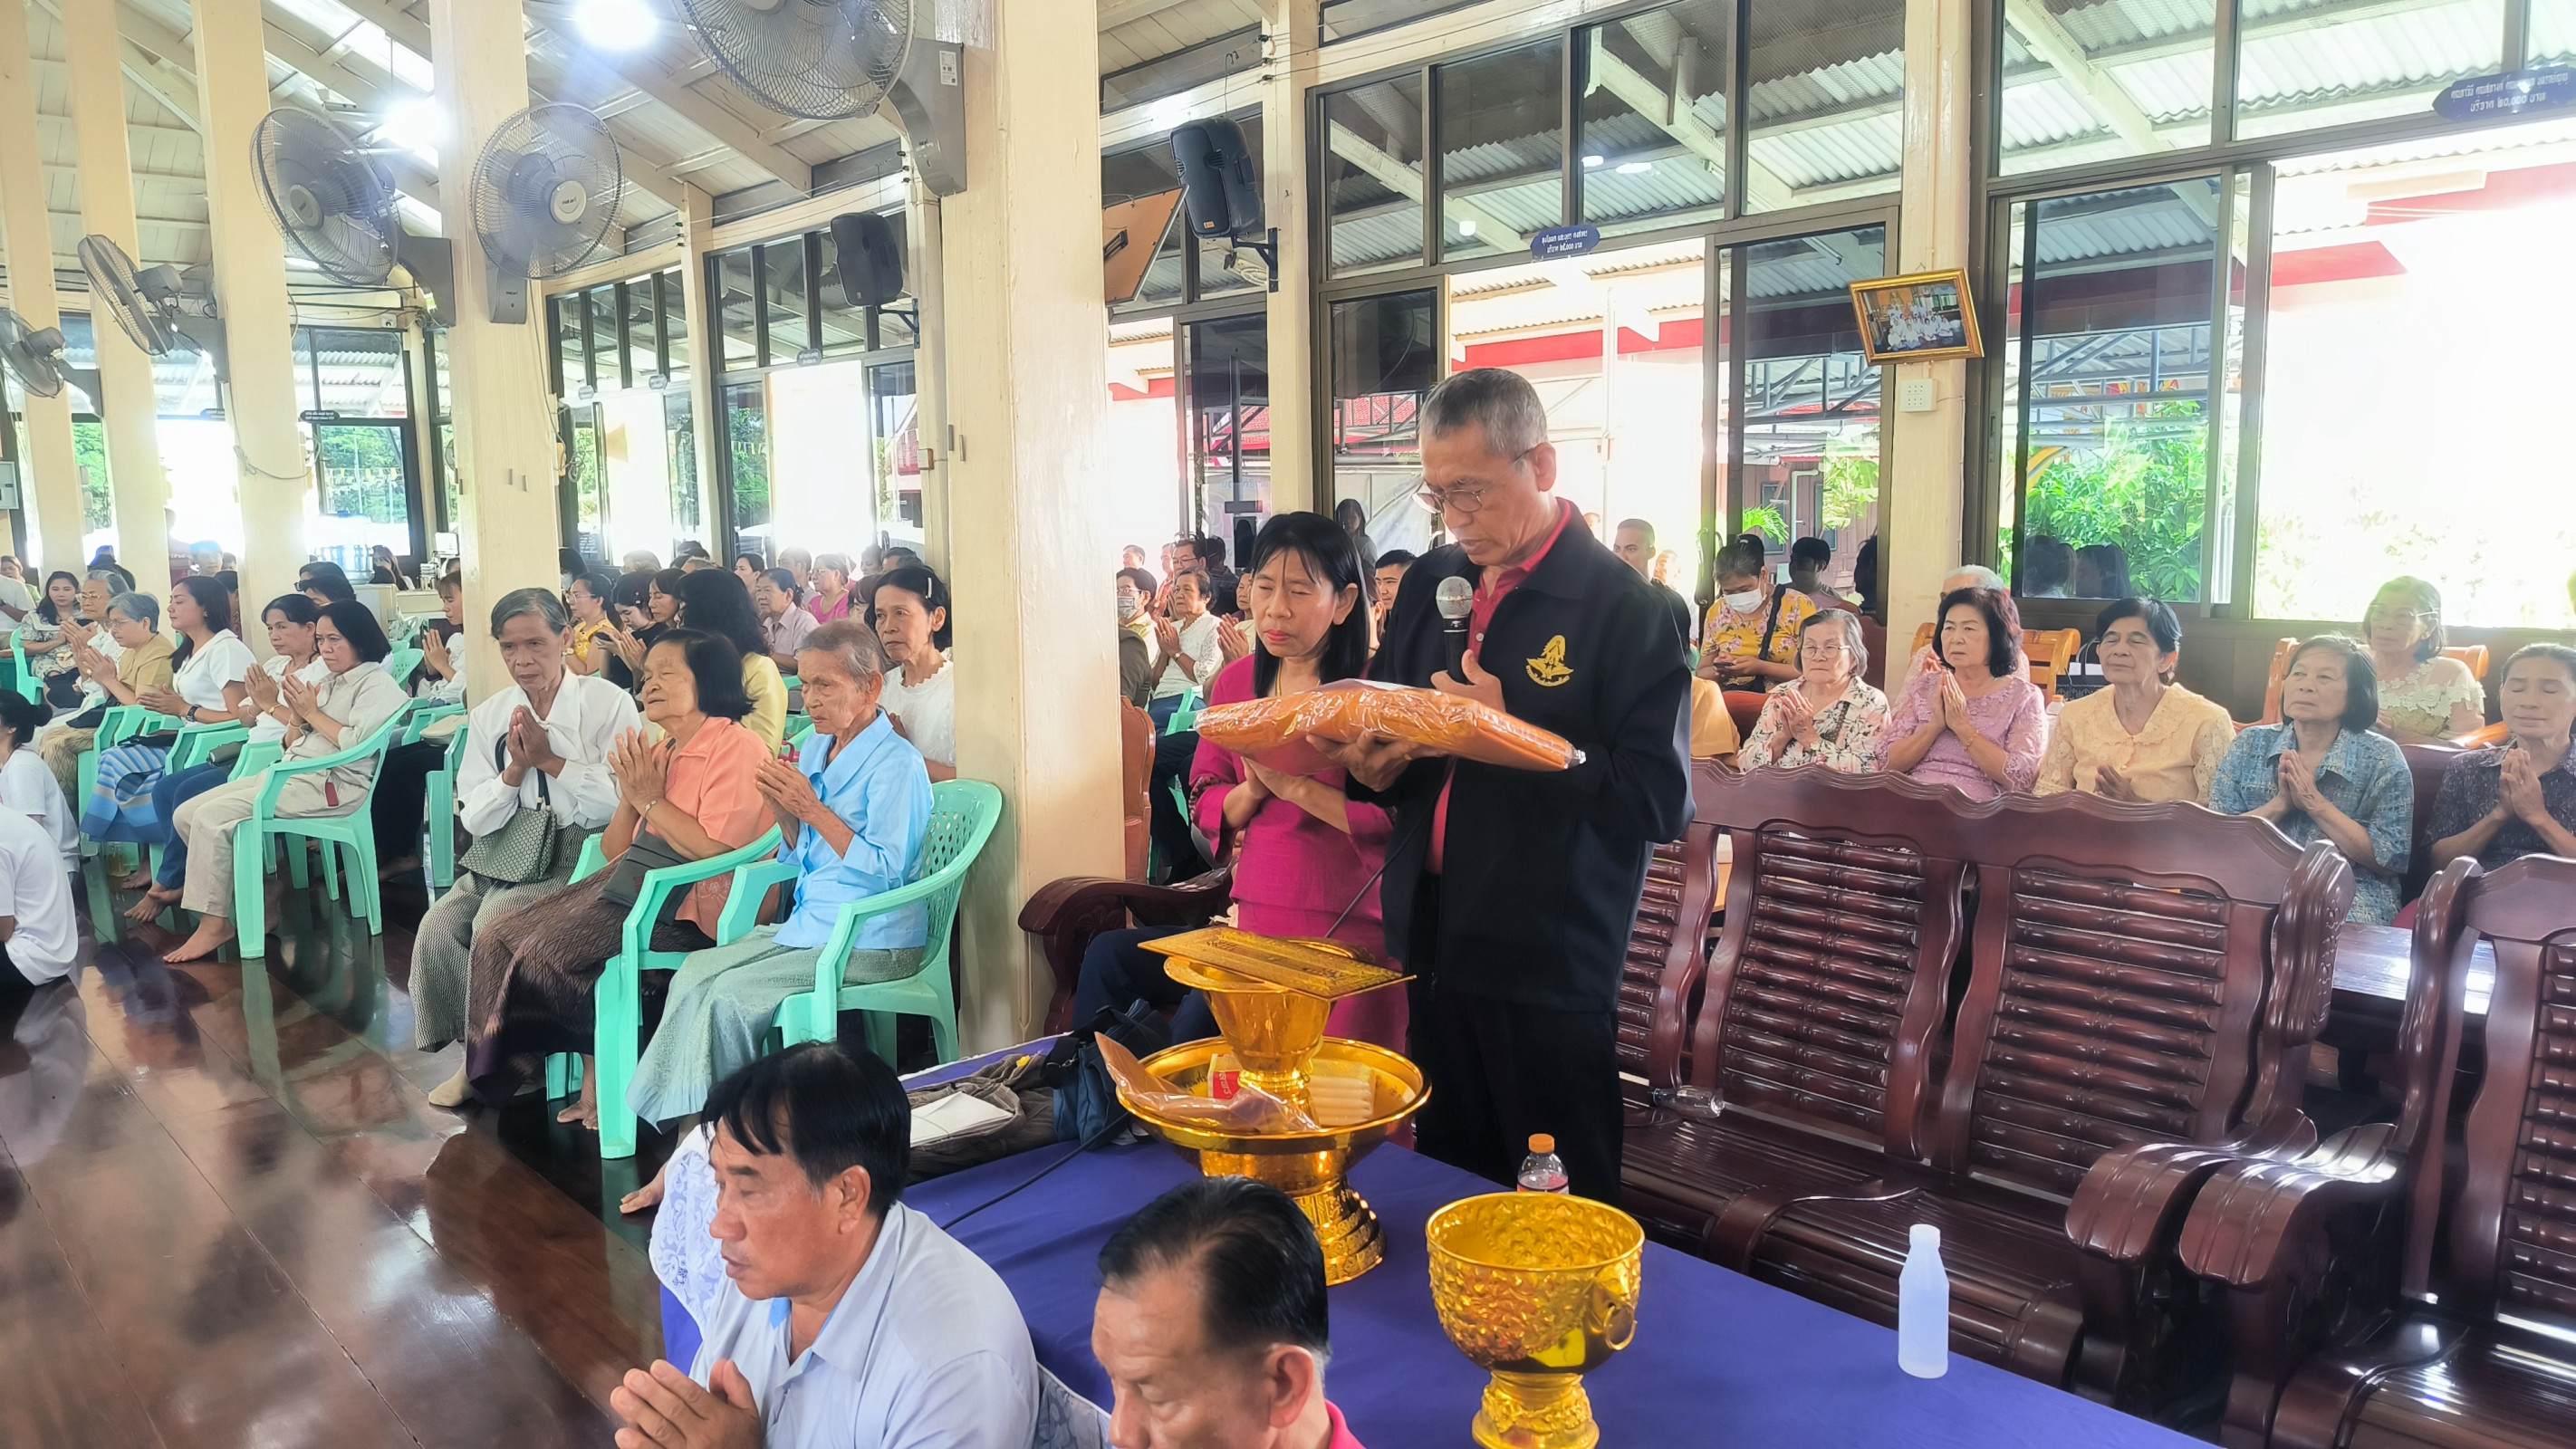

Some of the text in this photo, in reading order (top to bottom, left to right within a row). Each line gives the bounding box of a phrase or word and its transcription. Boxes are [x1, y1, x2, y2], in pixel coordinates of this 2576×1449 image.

[2470, 99, 2494, 112] บริจาค
[2529, 91, 2546, 103] บาท
